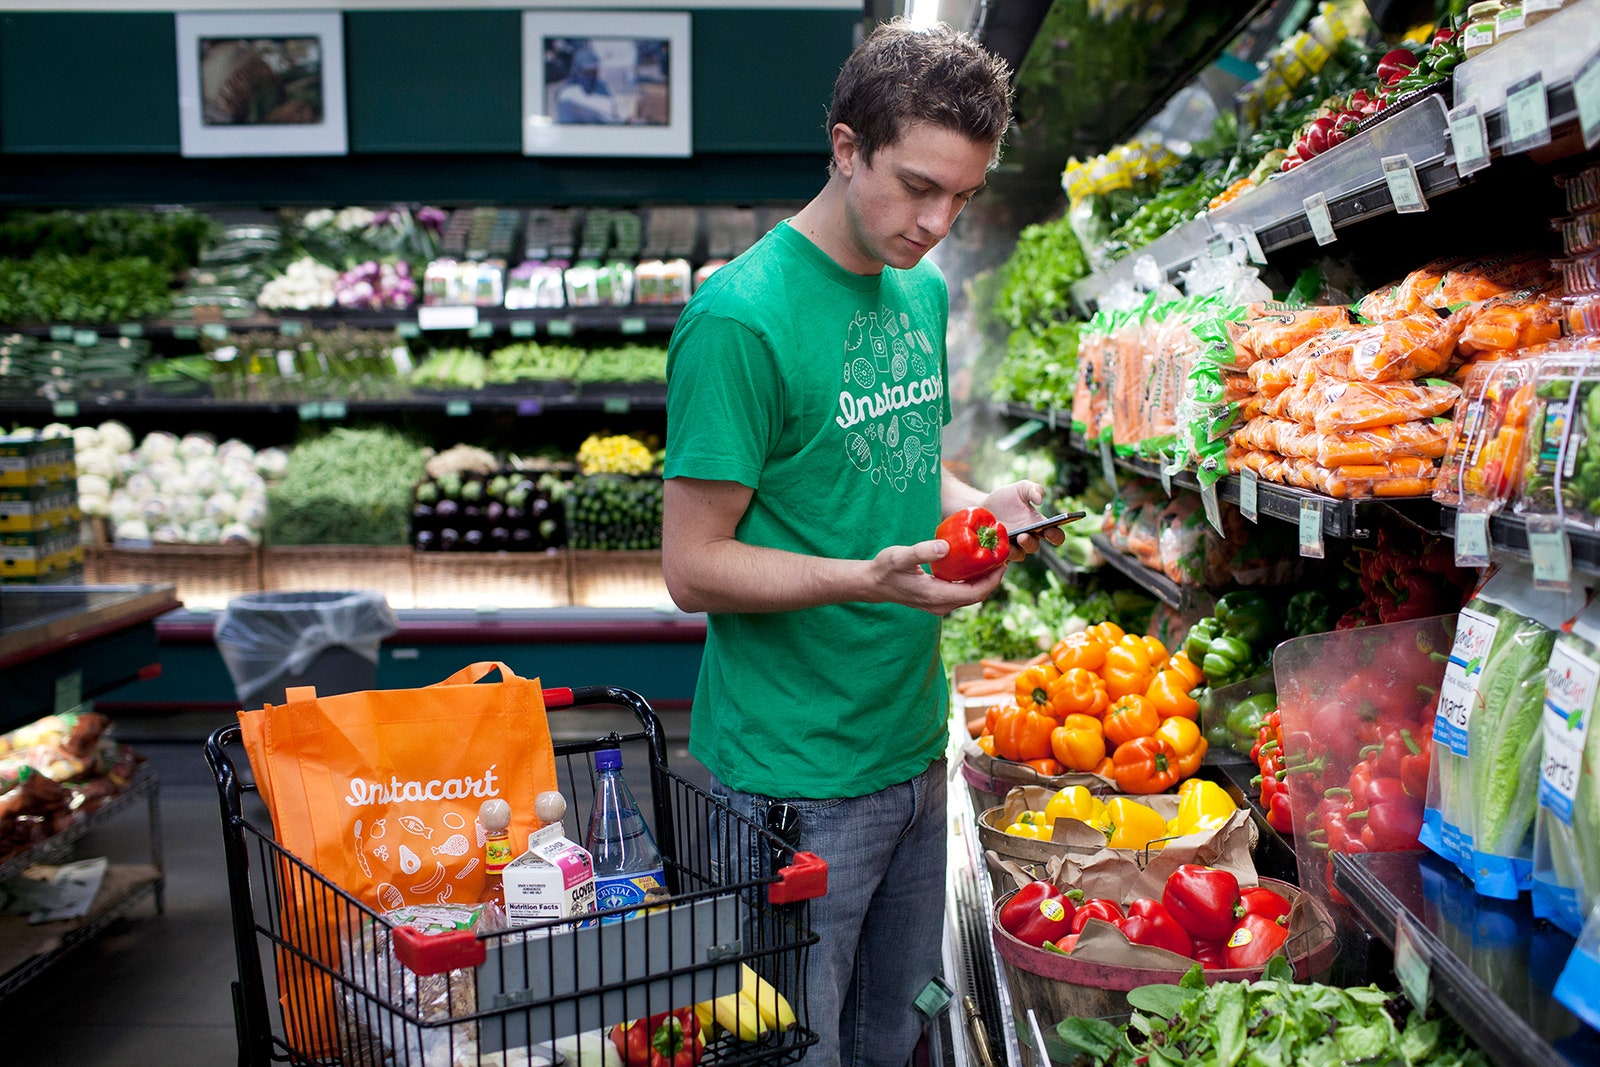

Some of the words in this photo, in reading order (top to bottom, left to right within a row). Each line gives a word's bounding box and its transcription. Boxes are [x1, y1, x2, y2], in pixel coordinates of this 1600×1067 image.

[345, 764, 500, 807] Instacart
[572, 881, 595, 901] CLOVER
[596, 886, 630, 901] CRYSTAL
